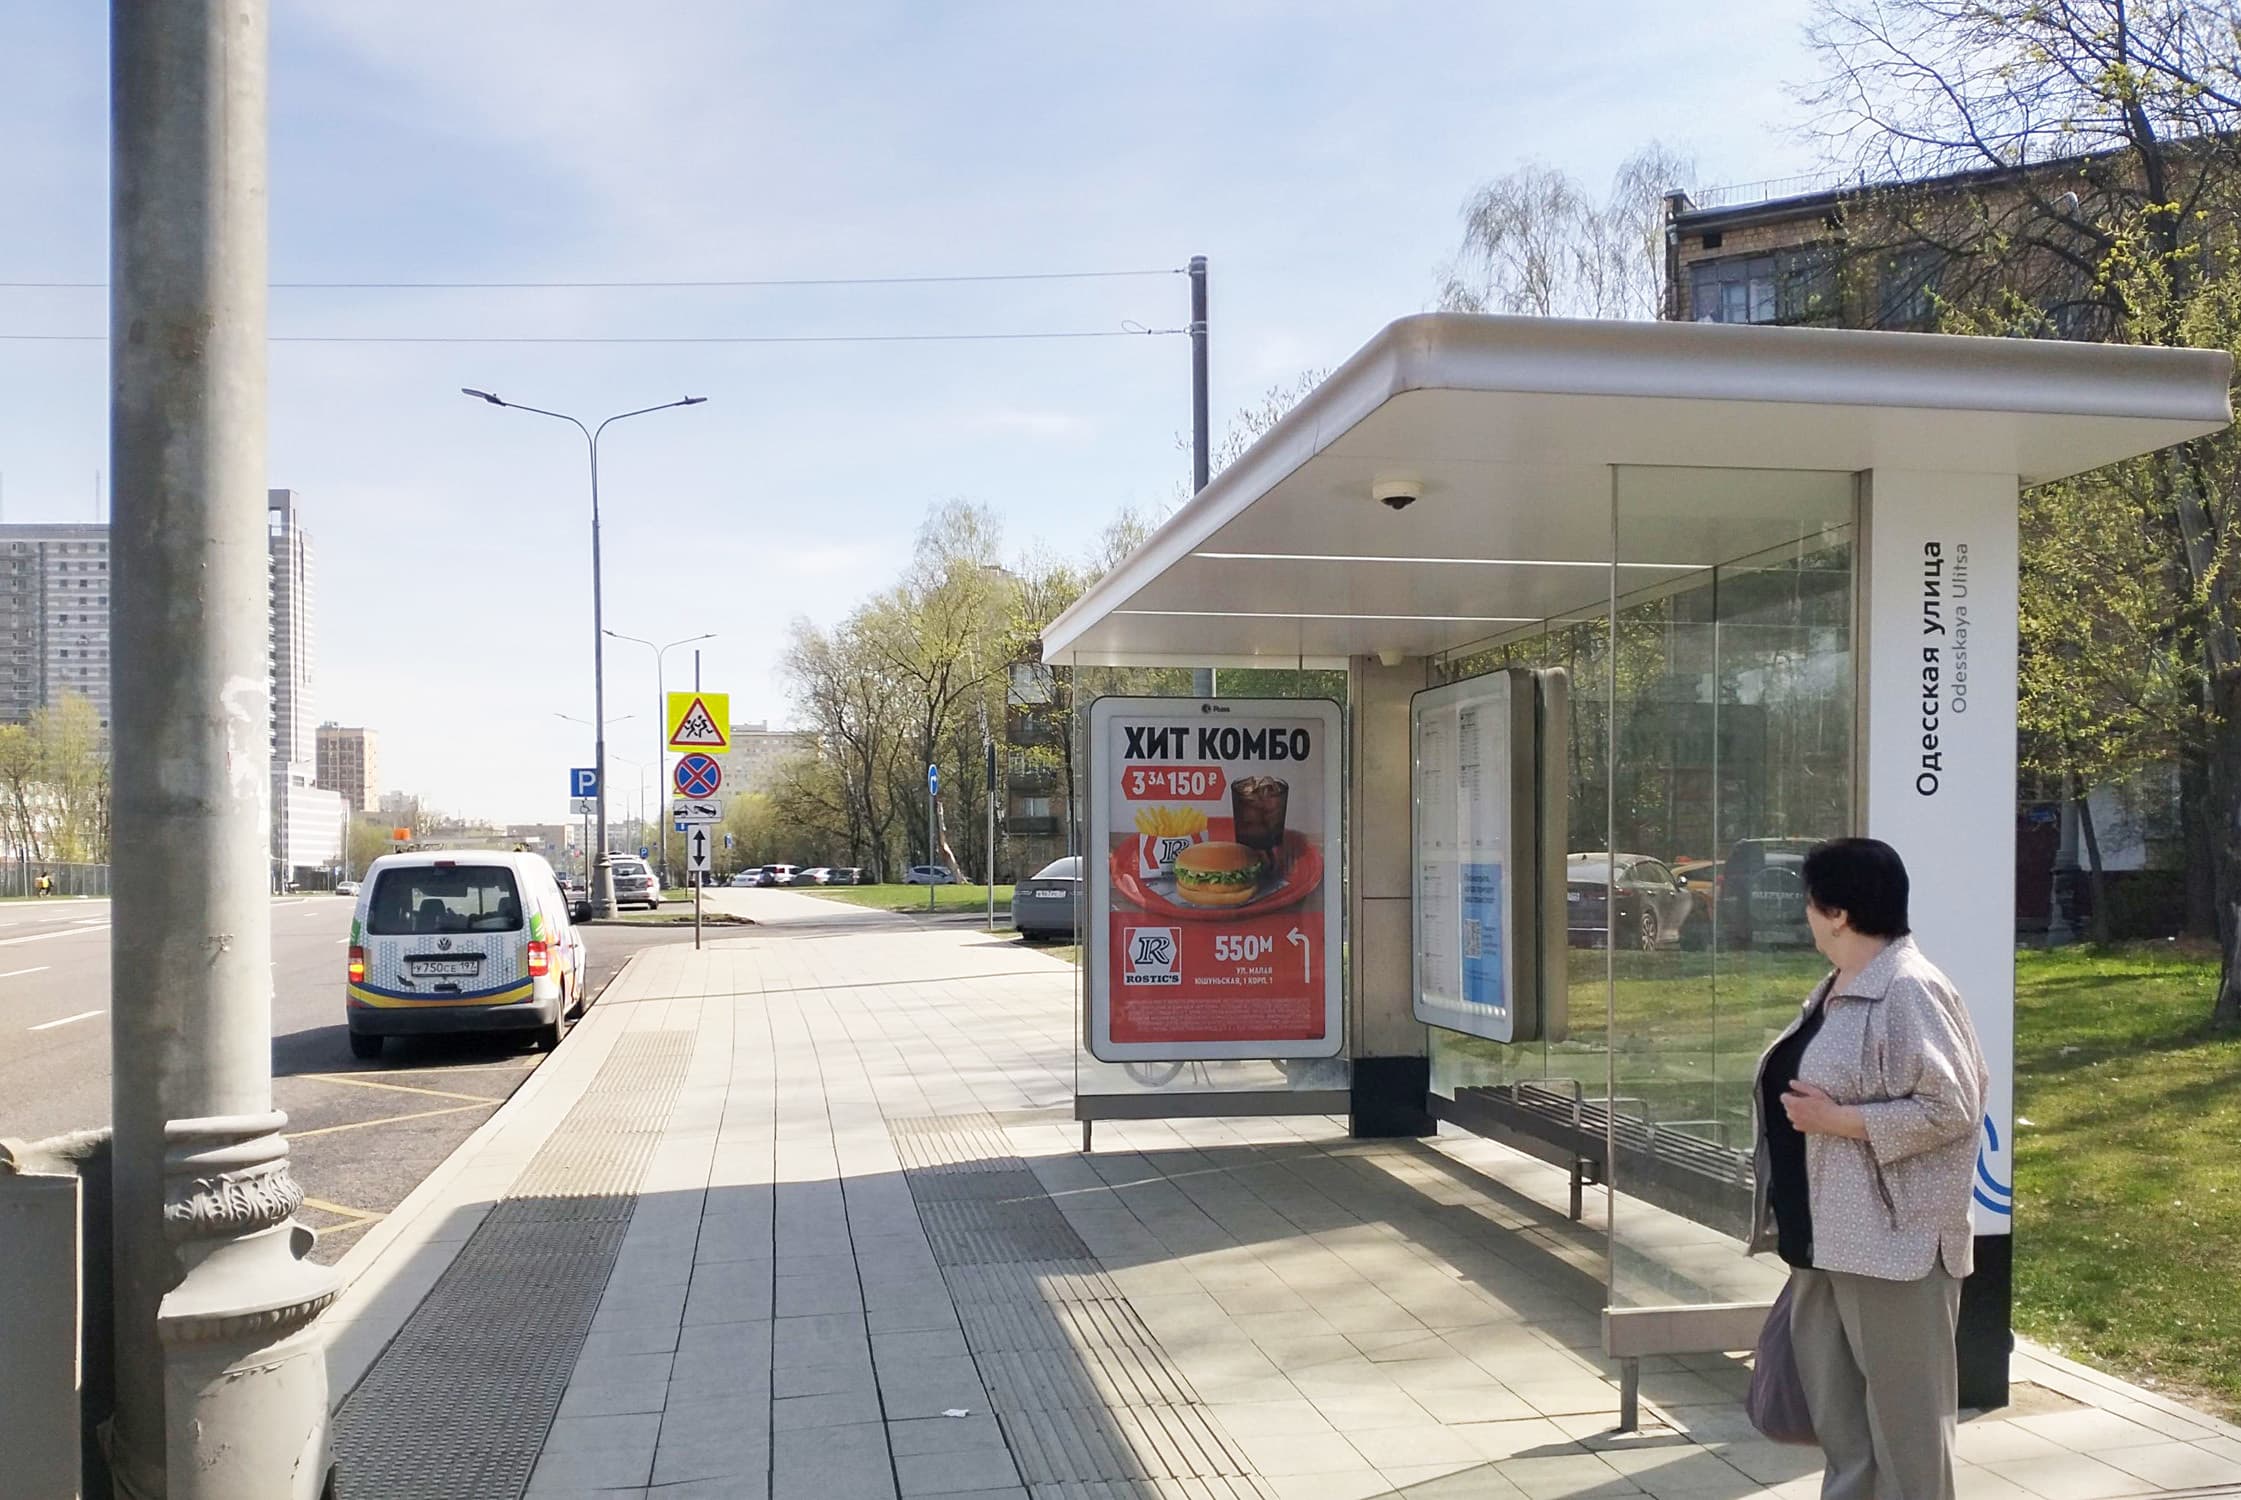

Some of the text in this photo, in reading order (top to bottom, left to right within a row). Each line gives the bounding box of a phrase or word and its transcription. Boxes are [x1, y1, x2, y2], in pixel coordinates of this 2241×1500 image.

[1952, 543, 1971, 713] Odesskaya Ulitsa
[1916, 541, 1945, 796] Одесская улица
[1124, 726, 1311, 761] ХИТ КОМБО
[578, 771, 596, 795] P
[1132, 771, 1146, 796] 3
[1148, 771, 1165, 786] ЗА
[1126, 975, 1180, 983] ROSTIC'S
